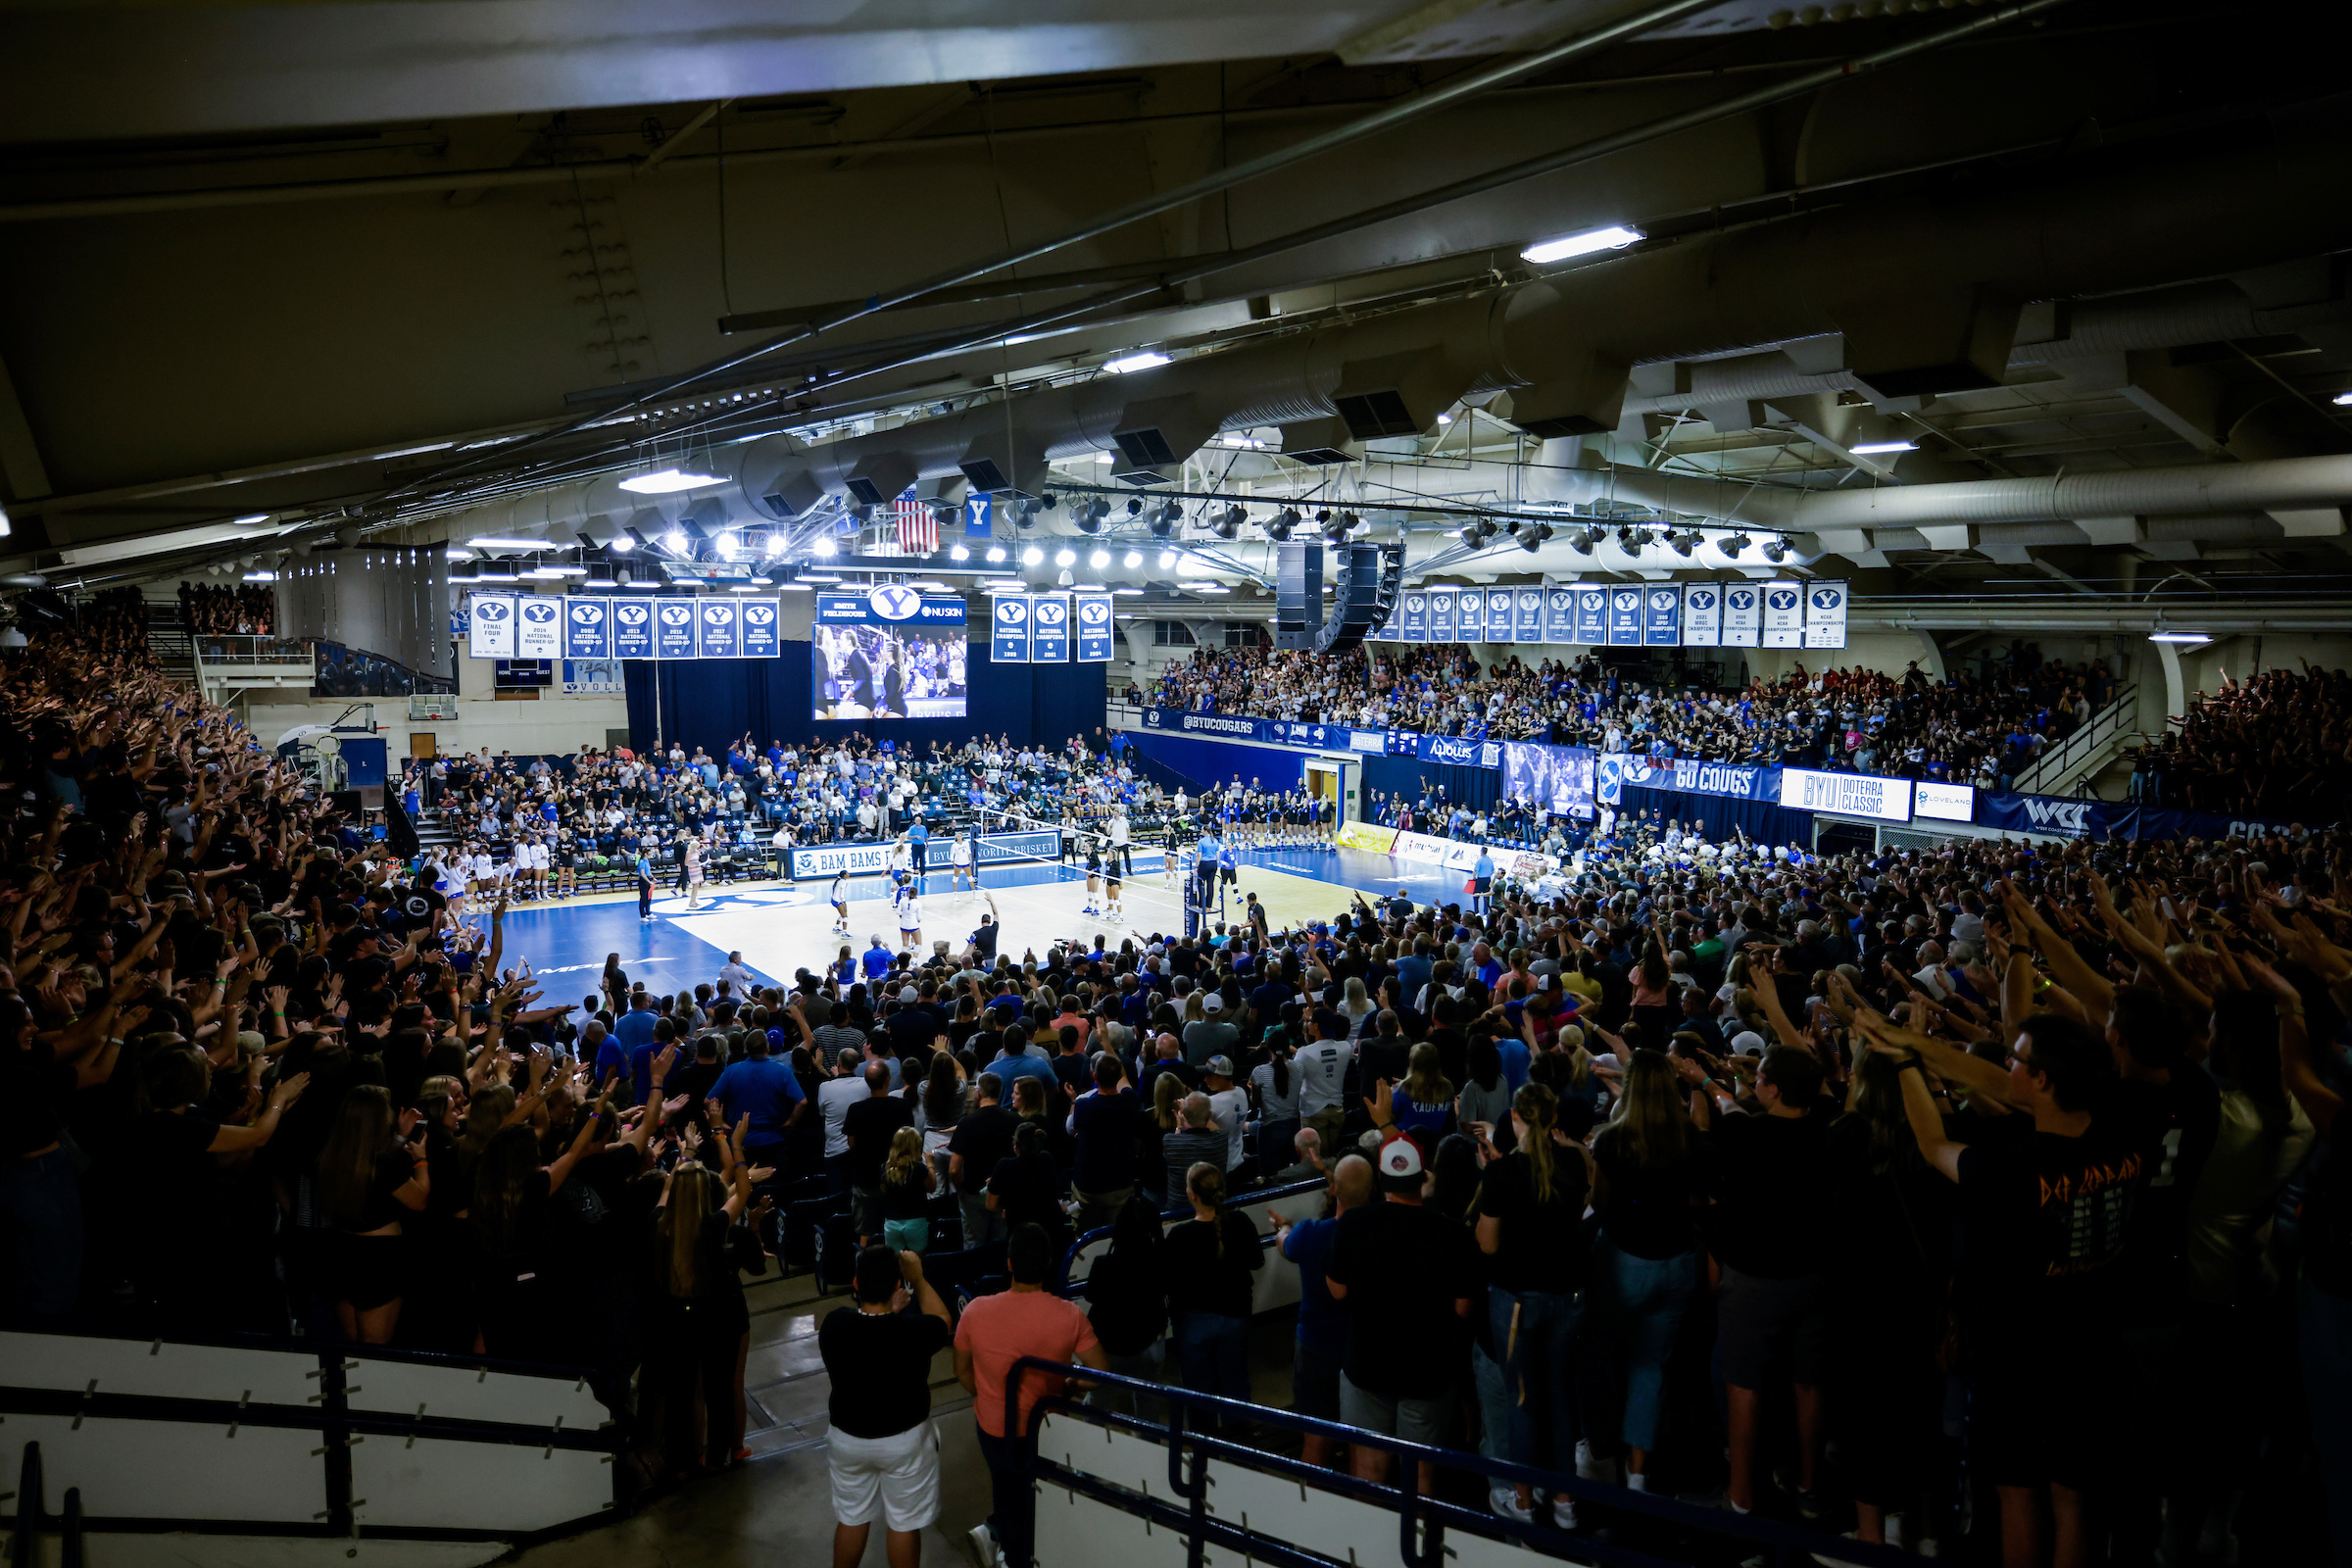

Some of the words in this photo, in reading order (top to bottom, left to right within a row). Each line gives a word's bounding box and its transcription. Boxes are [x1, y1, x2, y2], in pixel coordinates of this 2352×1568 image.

[969, 500, 987, 524] Y
[880, 589, 913, 616] Y
[1184, 715, 1253, 734] @BYUCOUGARS
[1430, 740, 1472, 758] smarty
[1676, 770, 1696, 789] GO
[1699, 767, 1753, 795] COUGS
[1843, 778, 1883, 797] DOTERRA
[1804, 774, 1836, 808] BYU
[1929, 796, 1972, 805] LOVELAND
[1842, 795, 1882, 814] CLASSIC
[2023, 798, 2093, 830] WCC
[978, 847, 1011, 858] VORITE
[1015, 843, 1053, 855] BRISKET
[821, 854, 846, 870] BAM
[850, 851, 881, 868] BAMS
[1412, 1101, 1451, 1113] KAUFMA
[2150, 1128, 2182, 1187] 1
